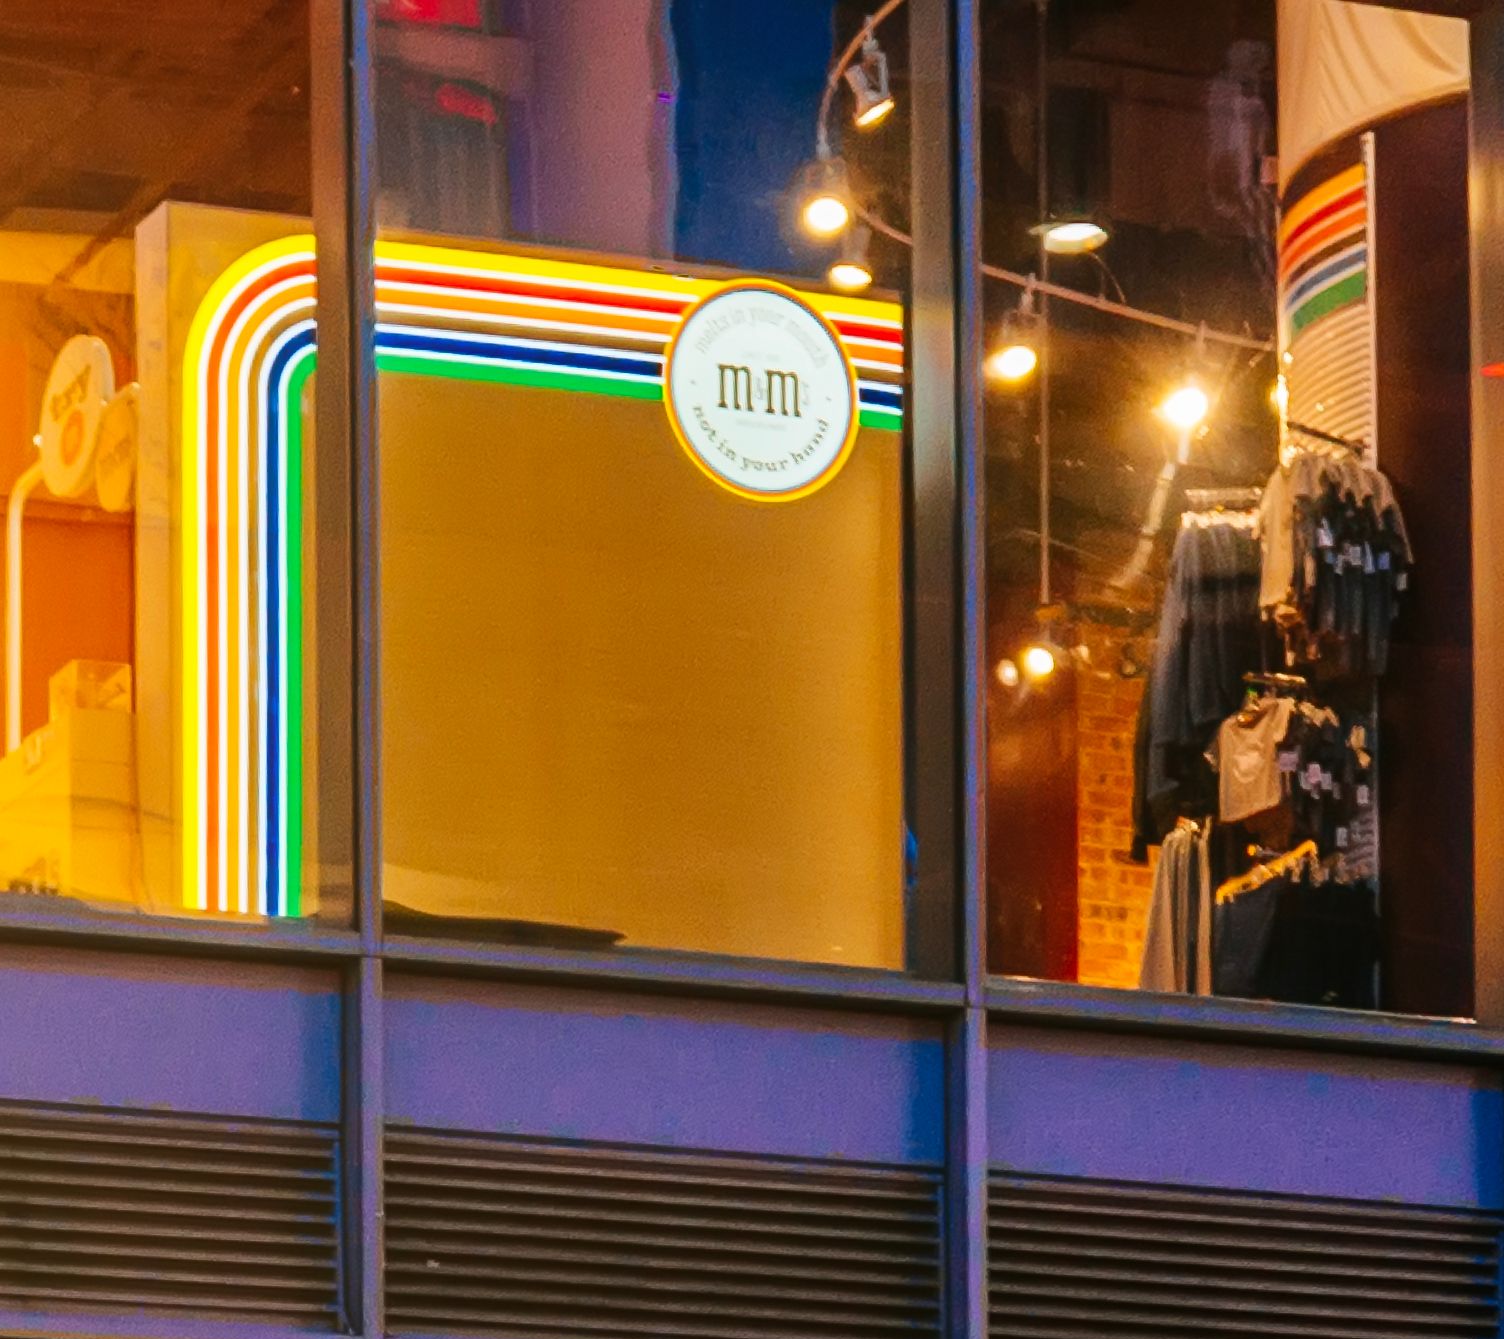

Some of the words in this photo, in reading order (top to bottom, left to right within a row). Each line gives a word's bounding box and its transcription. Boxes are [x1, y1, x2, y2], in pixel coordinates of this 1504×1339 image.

[693, 406, 718, 443] not
[717, 440, 737, 462] in
[741, 456, 789, 473] your
